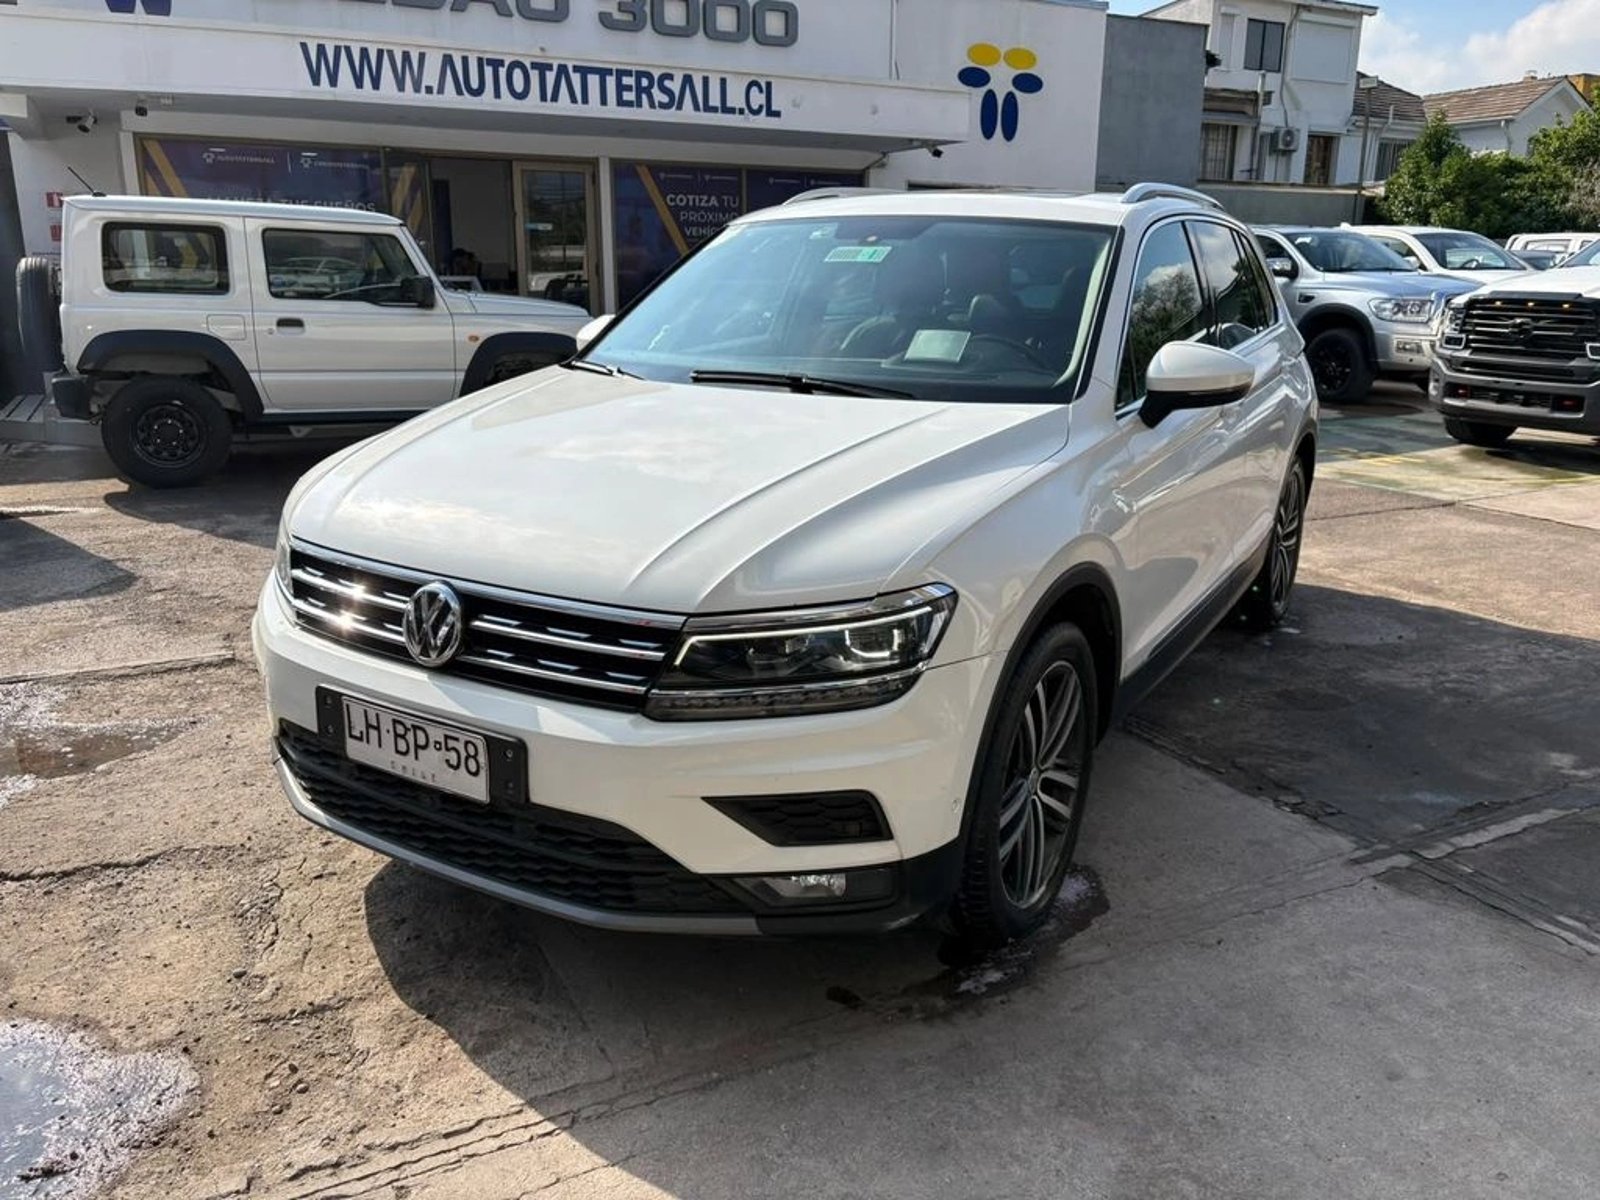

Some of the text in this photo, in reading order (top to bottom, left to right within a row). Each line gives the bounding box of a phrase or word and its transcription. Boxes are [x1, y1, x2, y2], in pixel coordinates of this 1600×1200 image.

[299, 41, 782, 118] WWW.AUTOTATTERSALL.CL
[666, 194, 739, 208] COTIZA TU
